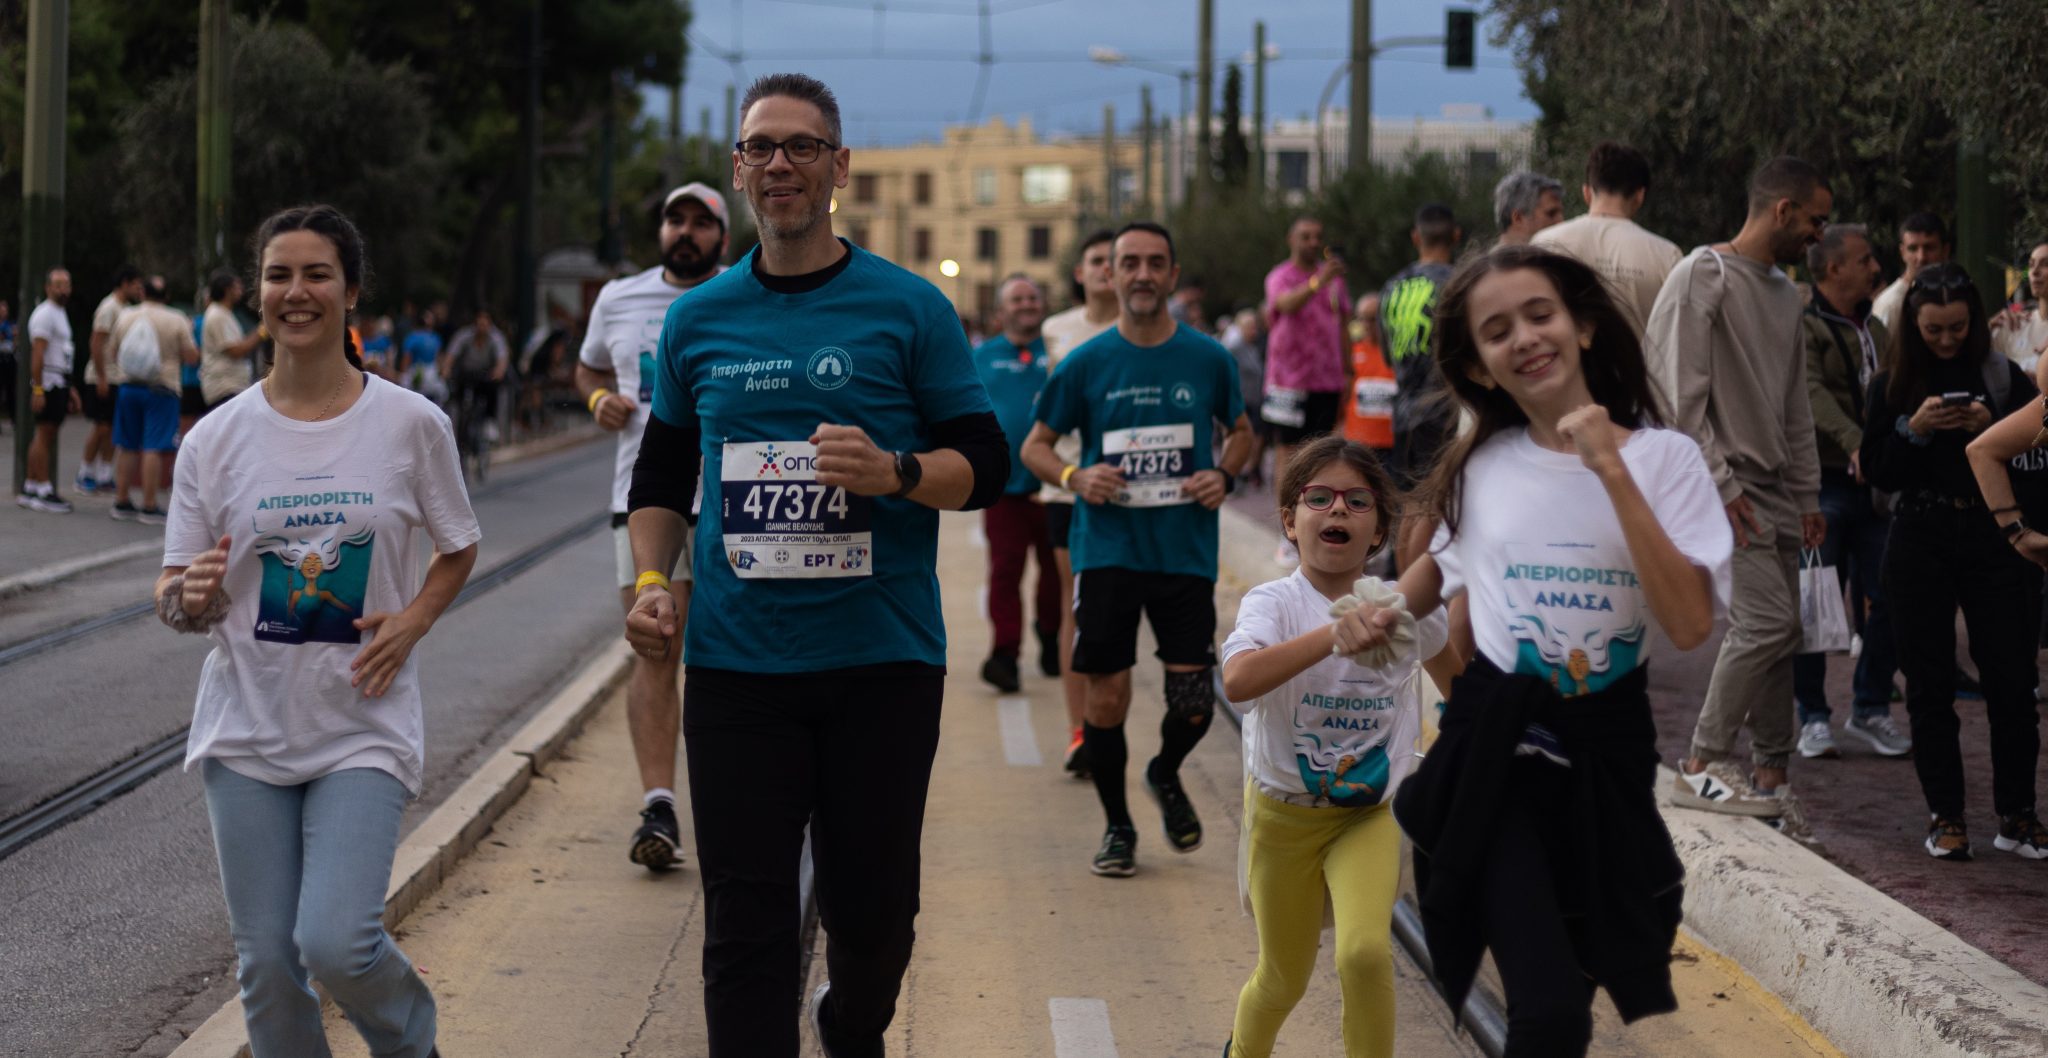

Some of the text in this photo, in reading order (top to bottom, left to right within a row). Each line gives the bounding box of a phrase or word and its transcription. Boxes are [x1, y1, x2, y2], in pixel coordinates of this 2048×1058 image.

[711, 358, 793, 379] Απεριόριστη
[745, 374, 789, 392] Ανάσα
[784, 456, 817, 471] ΟΠ
[1119, 449, 1182, 475] 47373
[257, 492, 373, 510] ΑΠΕΡΙΟΡΙΣΤΗ
[743, 484, 848, 521] 47374
[284, 511, 346, 528] ΑΝΑΣΑ
[766, 522, 824, 531] ΙΩΑΝΝΗΣ ΒΕΛΟΥΔΗΣ
[741, 535, 755, 543] 2023
[755, 535, 780, 543] ΑΓΩΝΑΣ
[782, 535, 810, 543] ΔΡΟΜΟΥ
[804, 554, 835, 567] ΕΡΤ
[1535, 591, 1614, 612] ΑΝΑΣΑ
[1301, 692, 1394, 711] ΑΠΕΡΙΟΡΙΣΤΗ
[1322, 716, 1378, 730] ΑΝΑΣΑ
